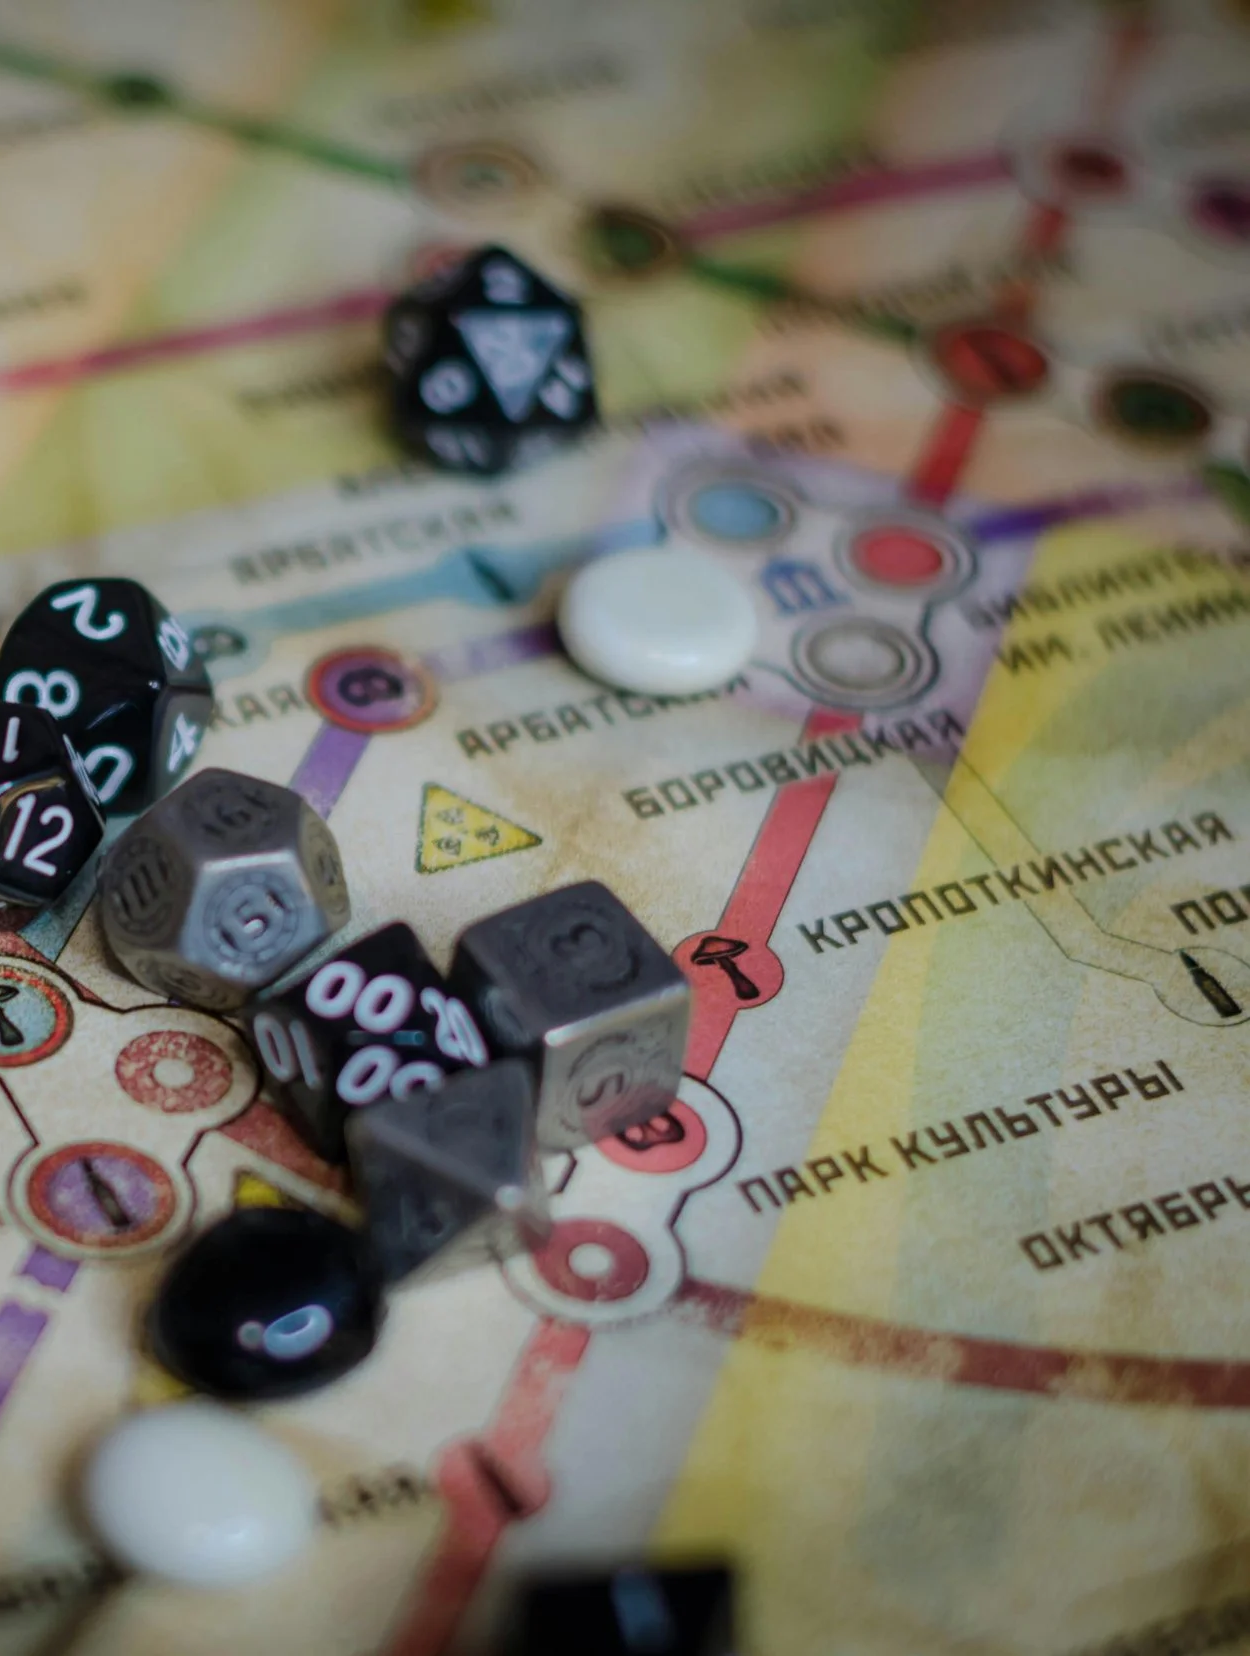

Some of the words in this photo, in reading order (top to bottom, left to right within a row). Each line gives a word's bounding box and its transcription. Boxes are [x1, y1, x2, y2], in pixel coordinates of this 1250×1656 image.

[52, 585, 126, 641] 2
[5, 669, 81, 719] 8
[621, 709, 967, 820] БОРОВИЦКАЯ
[2, 793, 75, 877] 12
[795, 808, 1238, 955] КРОПОТКИНСКАЯ
[305, 960, 415, 1034] 00
[734, 1142, 890, 1215] ПАРК
[889, 1058, 1187, 1173] КУЛЬТУРЫ
